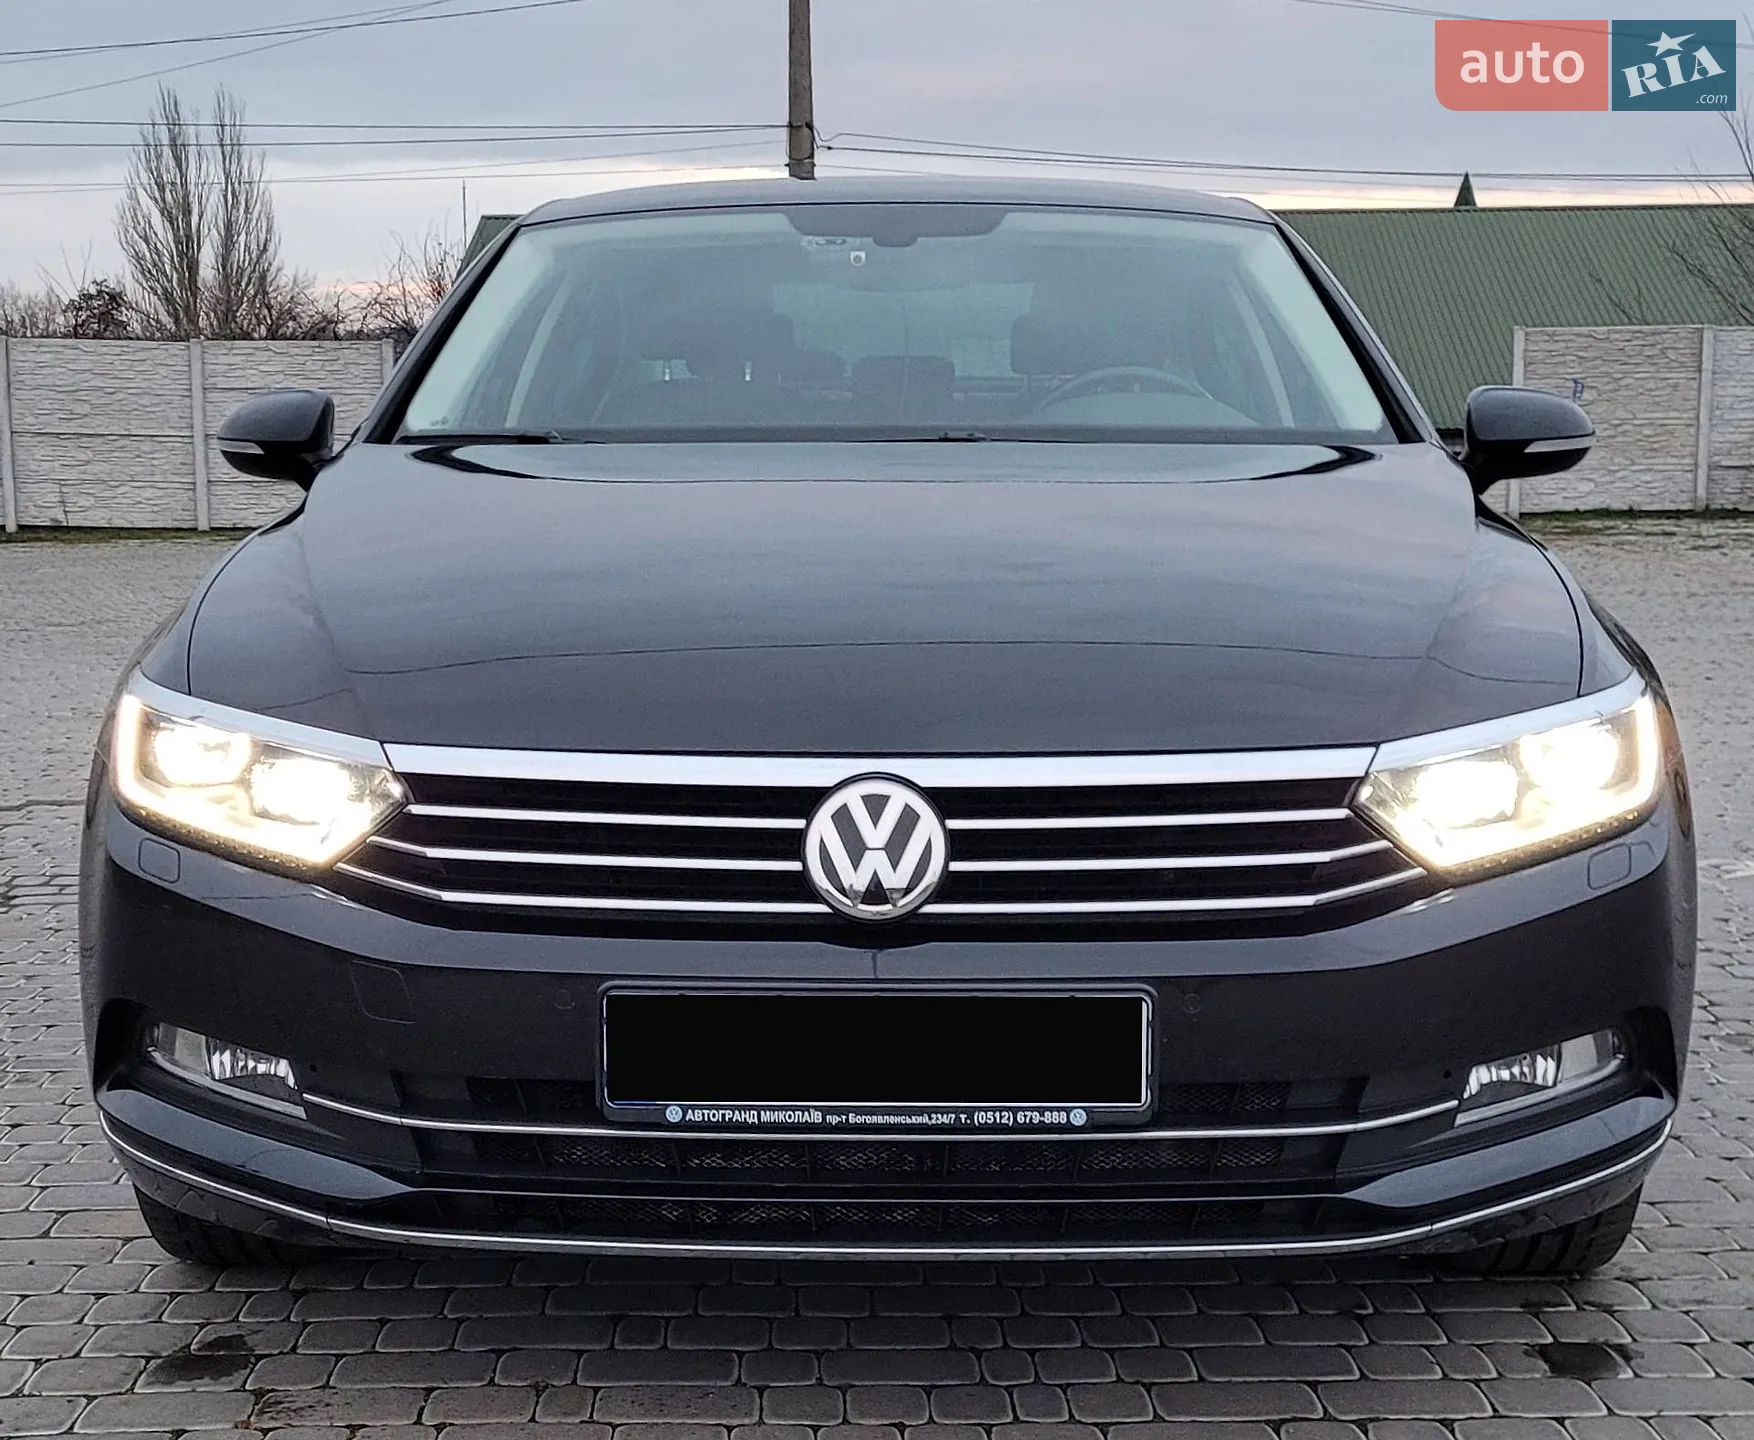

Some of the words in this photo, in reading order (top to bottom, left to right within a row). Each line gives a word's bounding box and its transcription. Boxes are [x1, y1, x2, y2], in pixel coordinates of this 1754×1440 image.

[685, 1109, 759, 1125] АВТОГРАНД
[760, 1108, 823, 1124] МИКОЛАЇВ
[973, 1111, 1014, 1127] (0512)
[1016, 1111, 1068, 1125] 679-888
